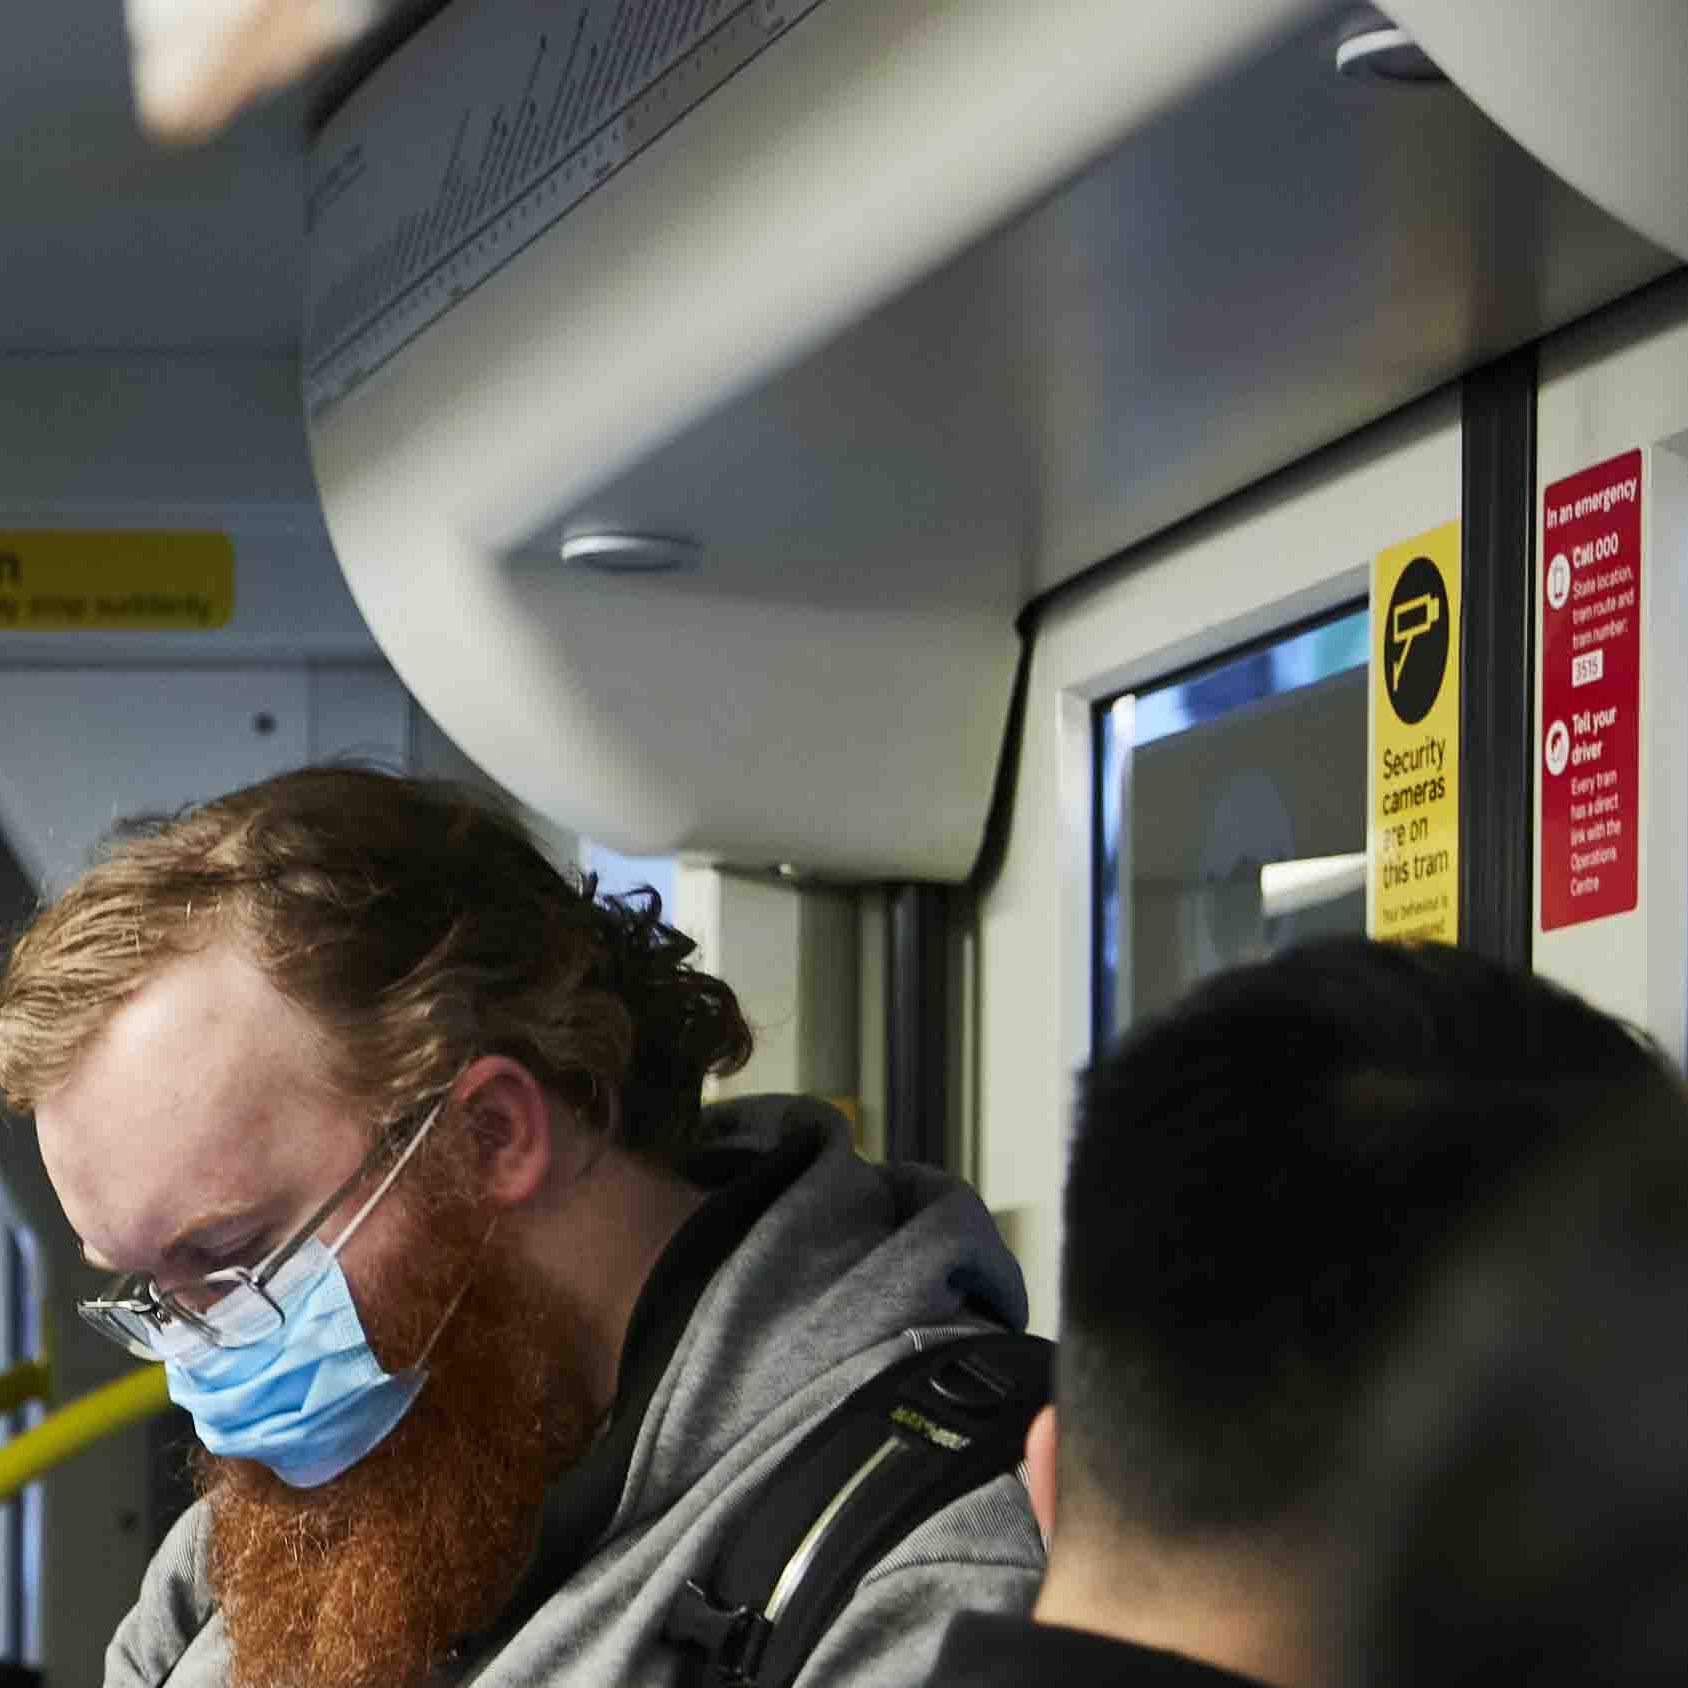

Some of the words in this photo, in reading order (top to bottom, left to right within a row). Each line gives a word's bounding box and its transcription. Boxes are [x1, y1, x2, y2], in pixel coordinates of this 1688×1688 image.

[1546, 506, 1557, 528] In
[1559, 504, 1572, 525] an
[1574, 478, 1637, 518] emergency
[1573, 543, 1594, 569] Call
[1596, 531, 1619, 560] 000
[1572, 709, 1591, 737] Tell
[1593, 706, 1617, 736] your
[1383, 736, 1447, 780] Security
[1571, 740, 1603, 766] driver
[1382, 775, 1446, 815] cameras
[1383, 822, 1406, 851] are
[1409, 816, 1429, 843] on
[1383, 855, 1409, 889] this
[1413, 849, 1449, 881] tram
